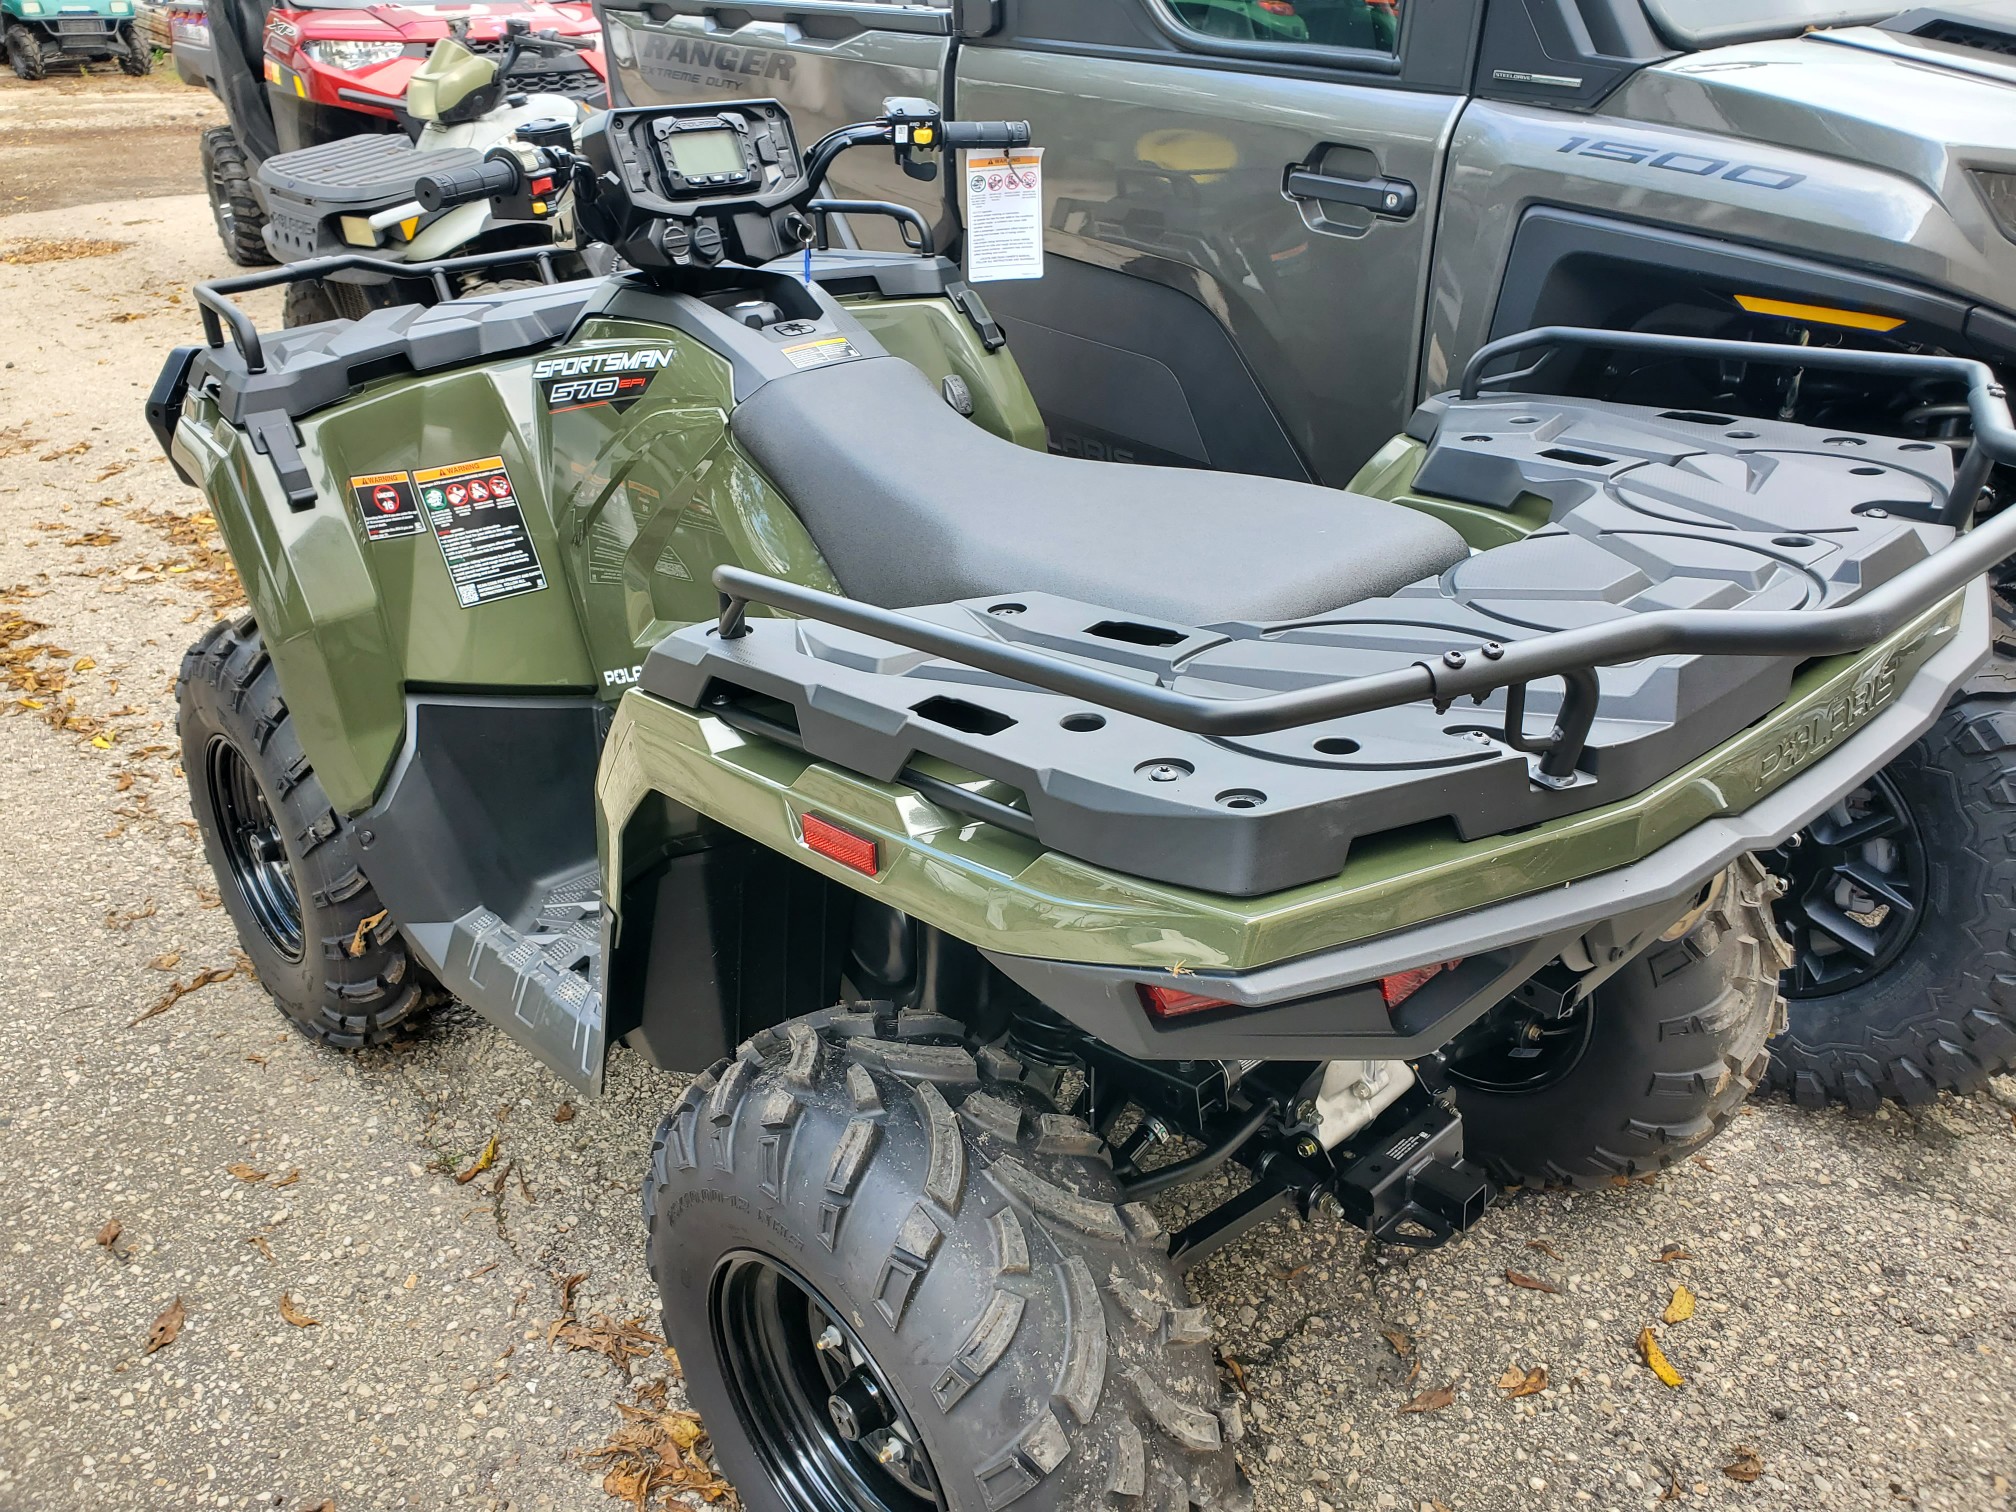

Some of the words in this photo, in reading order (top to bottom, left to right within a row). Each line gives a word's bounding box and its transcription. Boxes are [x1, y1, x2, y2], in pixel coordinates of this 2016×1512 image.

[265, 17, 297, 36] XP
[643, 33, 797, 82] RANGER
[640, 64, 701, 84] EXTREME
[705, 76, 743, 90] DUTY
[1495, 72, 1531, 80] STEELDRIVE
[1556, 136, 1807, 190] 1500
[532, 348, 675, 379] SPORTSMAN
[549, 377, 620, 403] 570
[618, 377, 646, 389] EFI
[368, 474, 398, 484] WARNING
[446, 463, 480, 474] WARNING
[382, 501, 395, 510] 16
[1754, 660, 1898, 792] POLARIS
